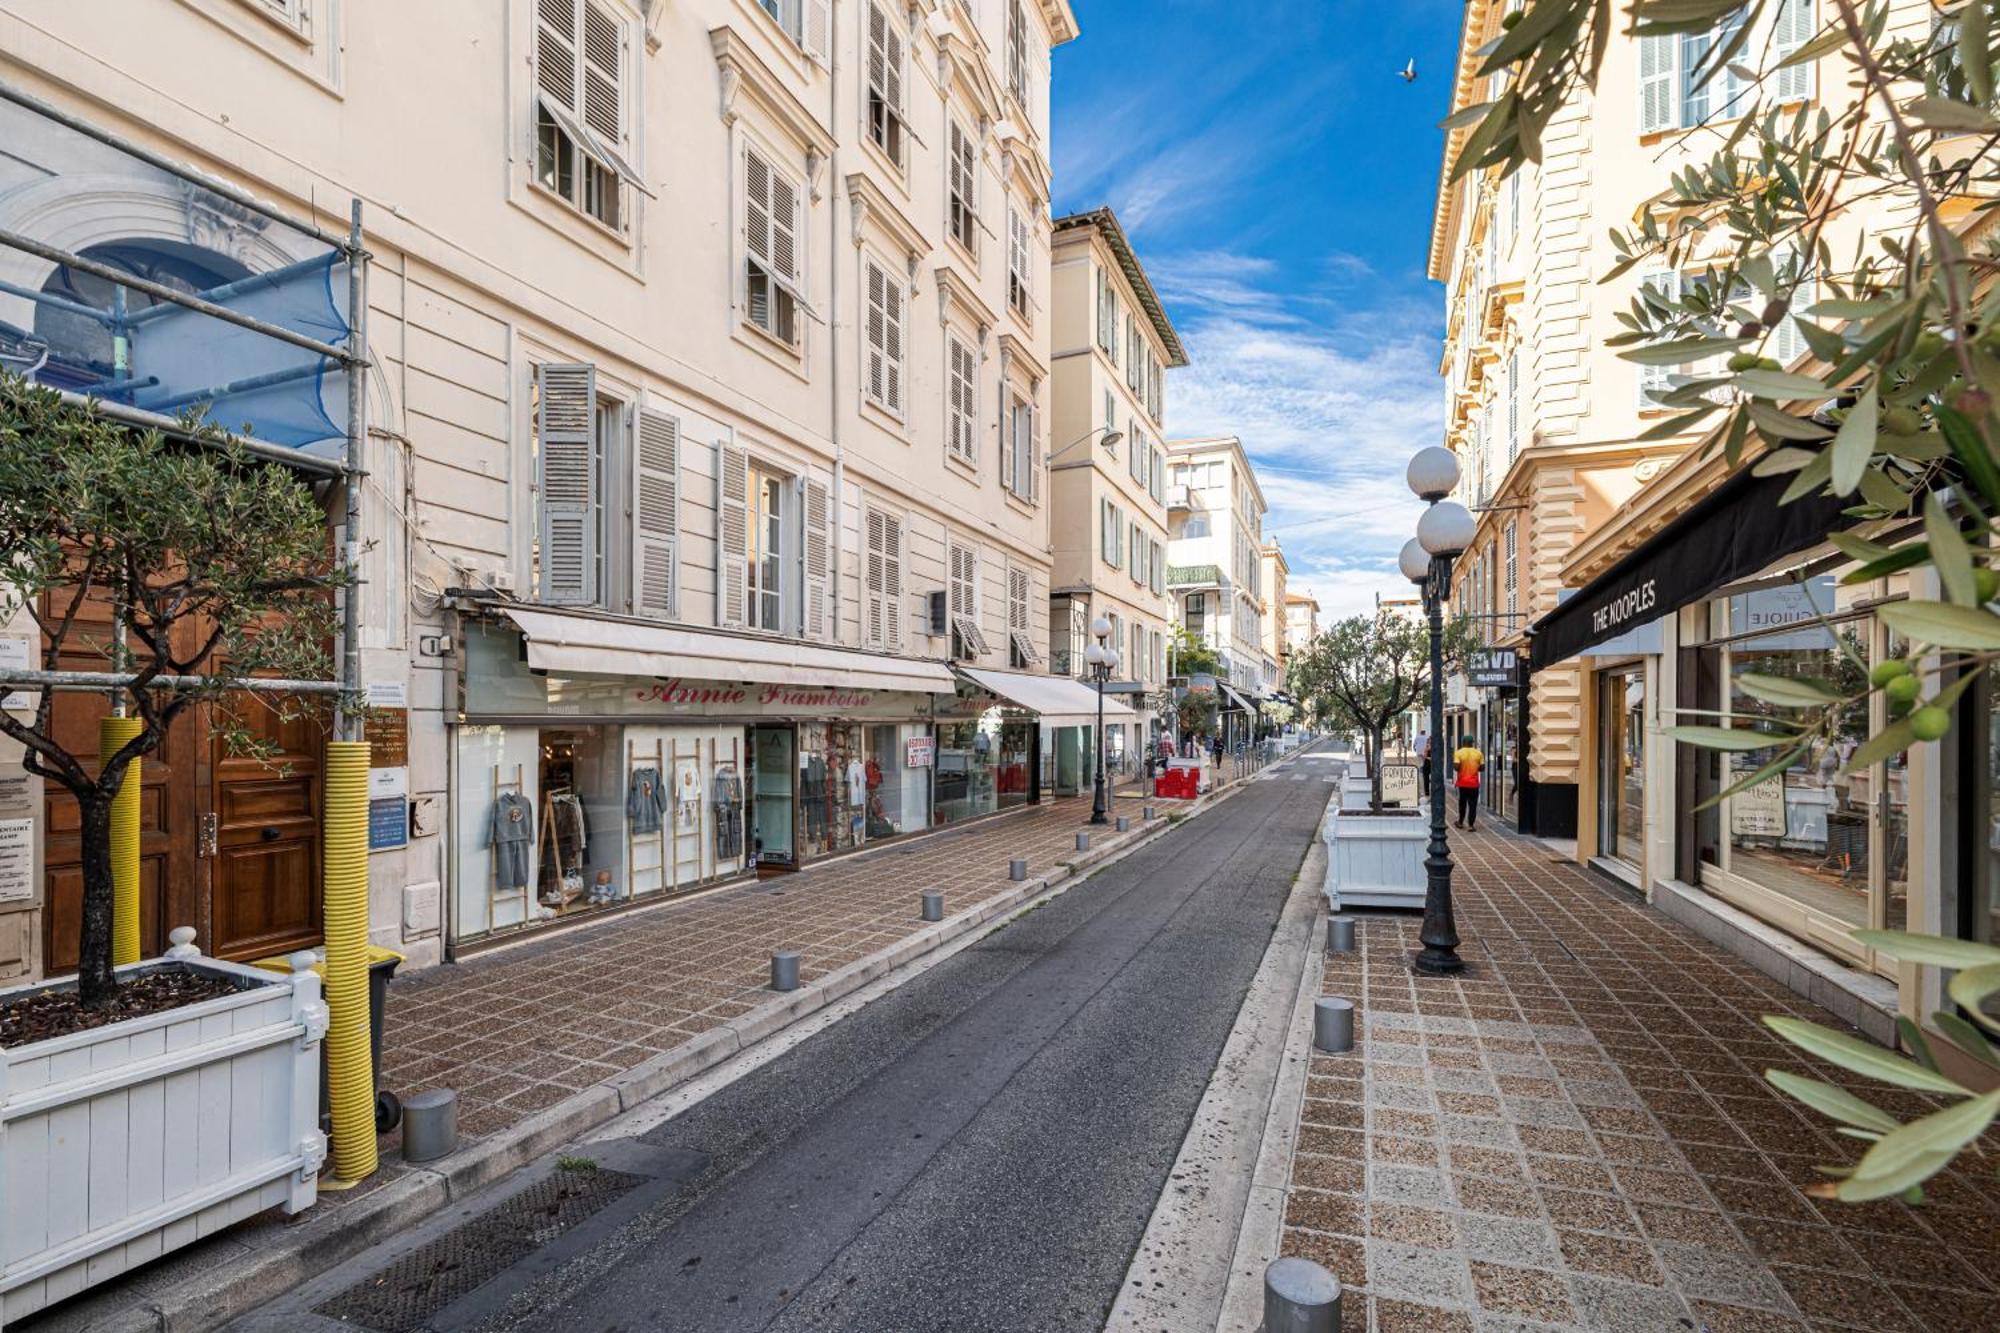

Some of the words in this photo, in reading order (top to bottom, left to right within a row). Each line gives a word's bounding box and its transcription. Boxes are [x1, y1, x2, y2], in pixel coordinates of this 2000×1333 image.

[1592, 605, 1608, 633] THE
[1608, 579, 1656, 626] KOOPLES
[637, 678, 747, 705] Annie
[758, 682, 873, 707] Framboise
